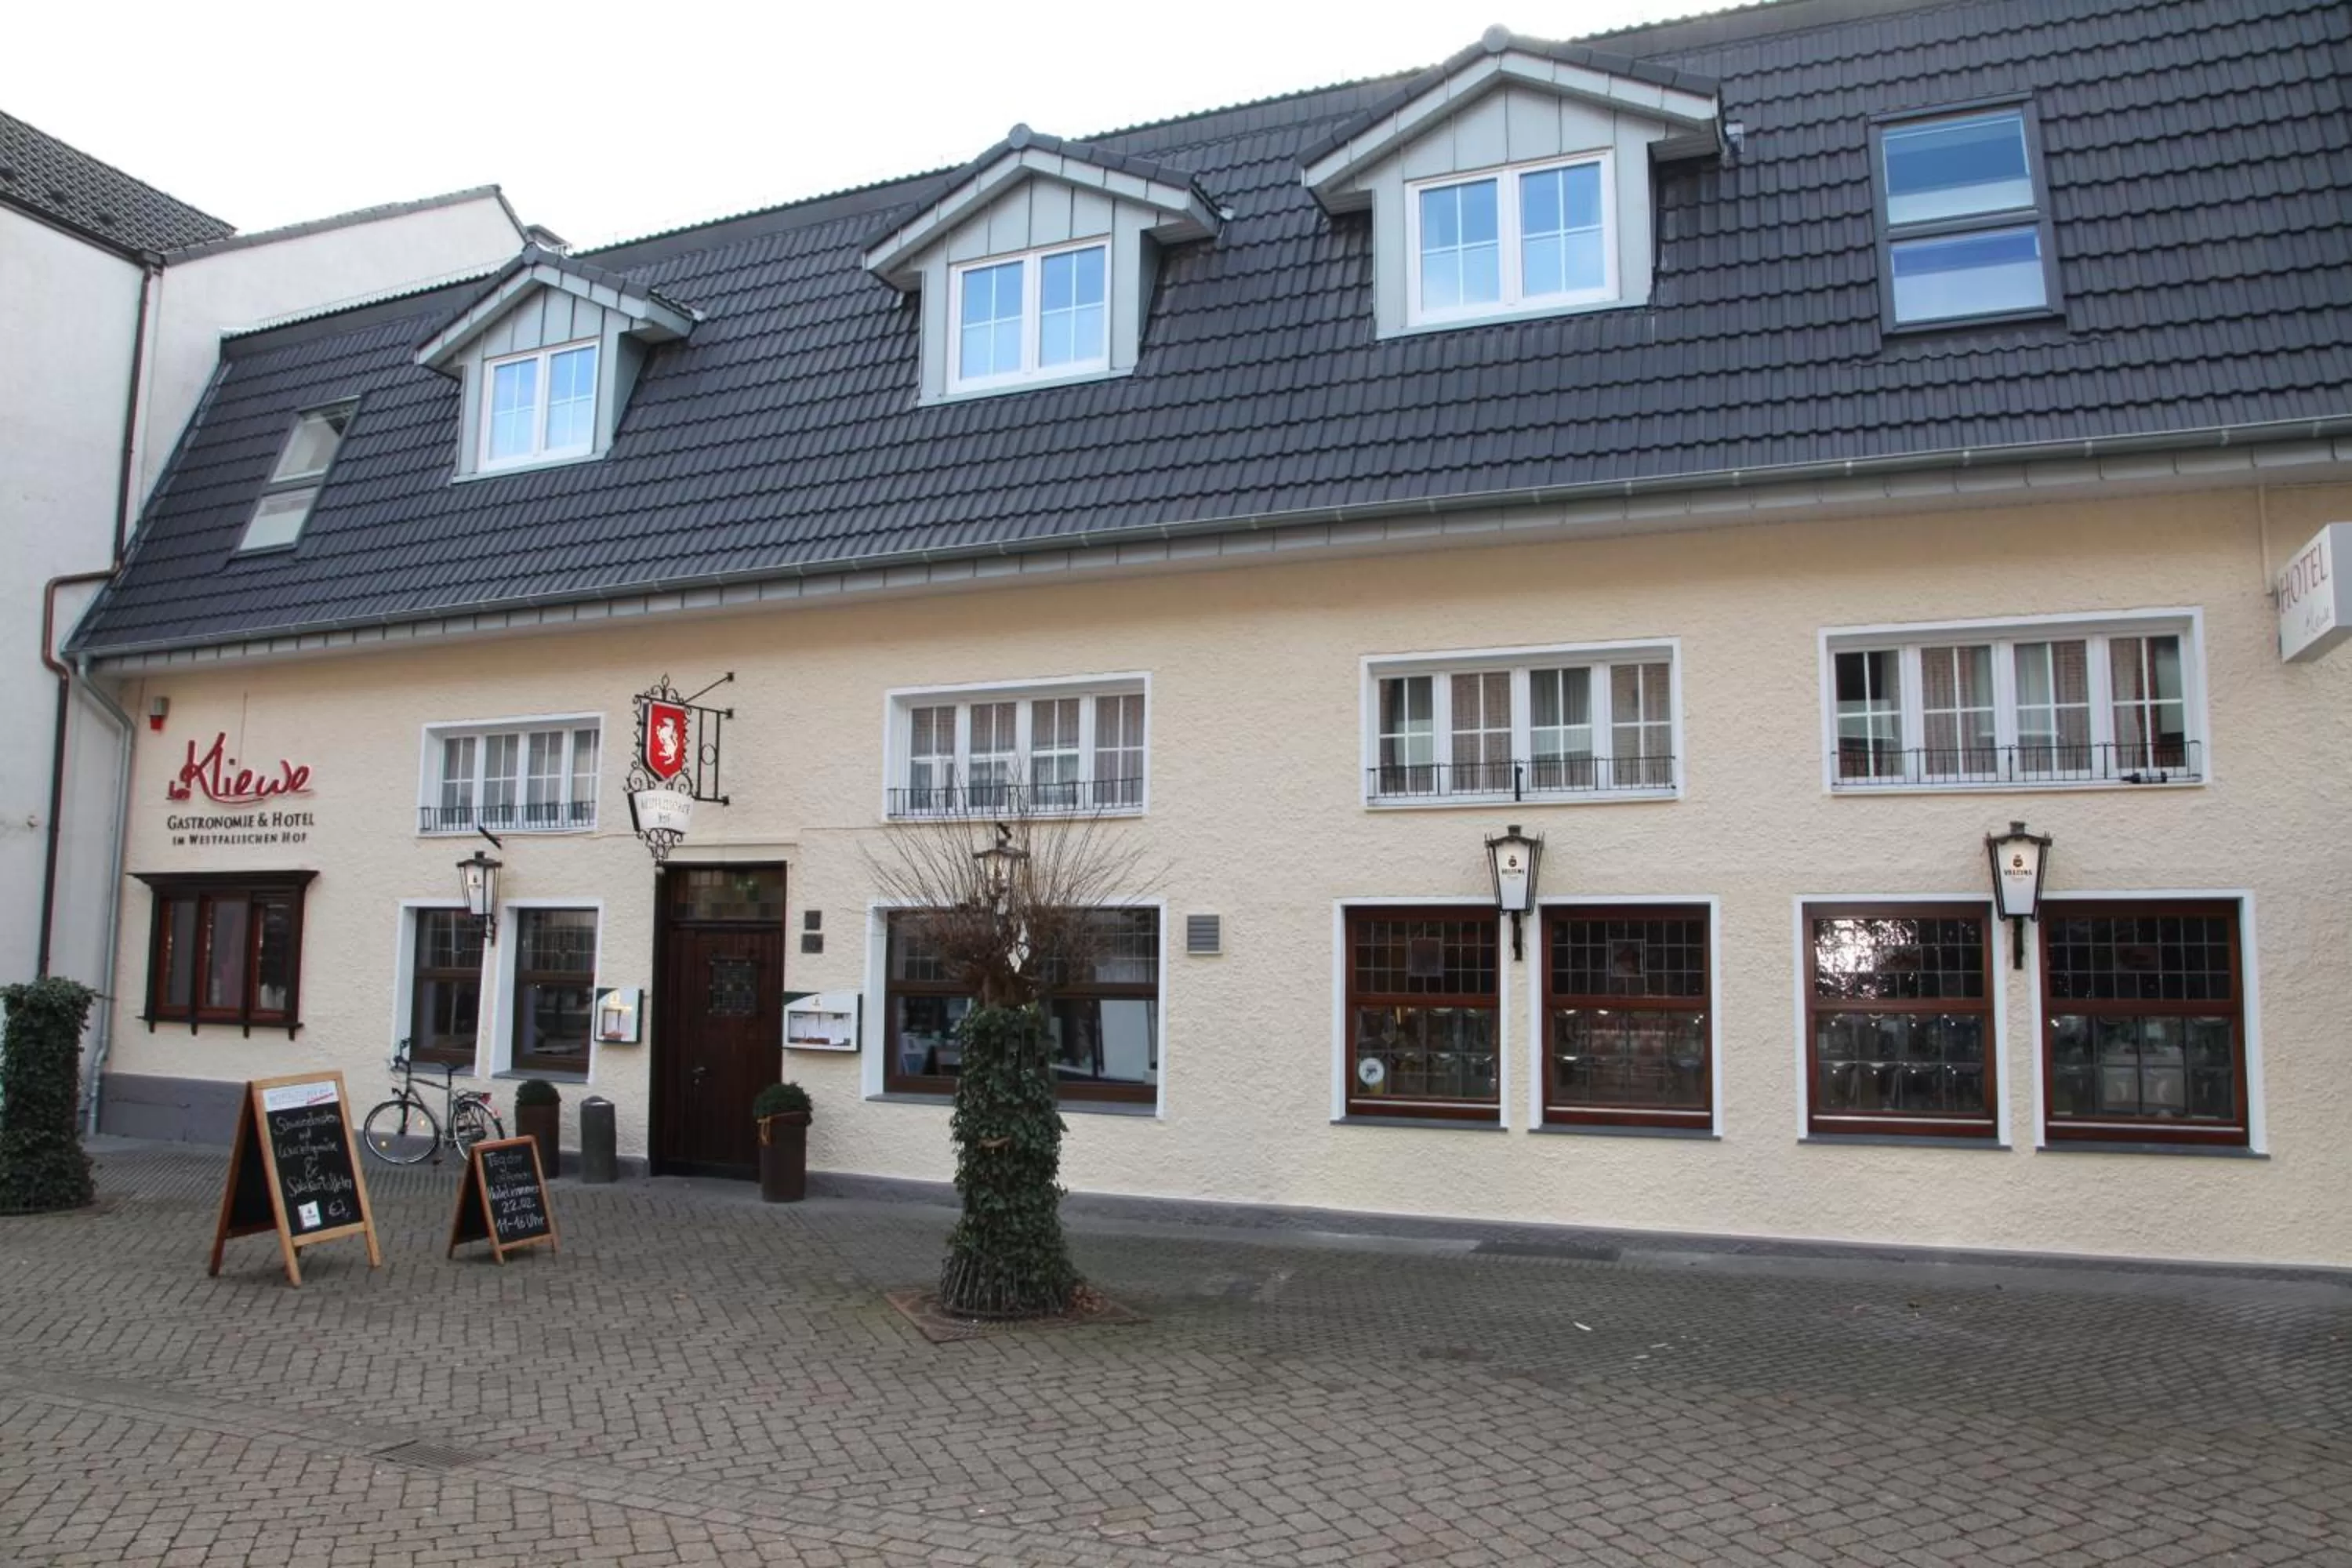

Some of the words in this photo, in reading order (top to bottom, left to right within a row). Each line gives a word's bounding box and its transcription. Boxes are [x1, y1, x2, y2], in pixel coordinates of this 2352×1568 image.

[2280, 543, 2328, 614] HOTEL
[167, 815, 254, 830] GASTRONOMIE
[257, 812, 267, 827] &
[272, 811, 314, 827] HOTEL
[281, 831, 307, 844] HOF
